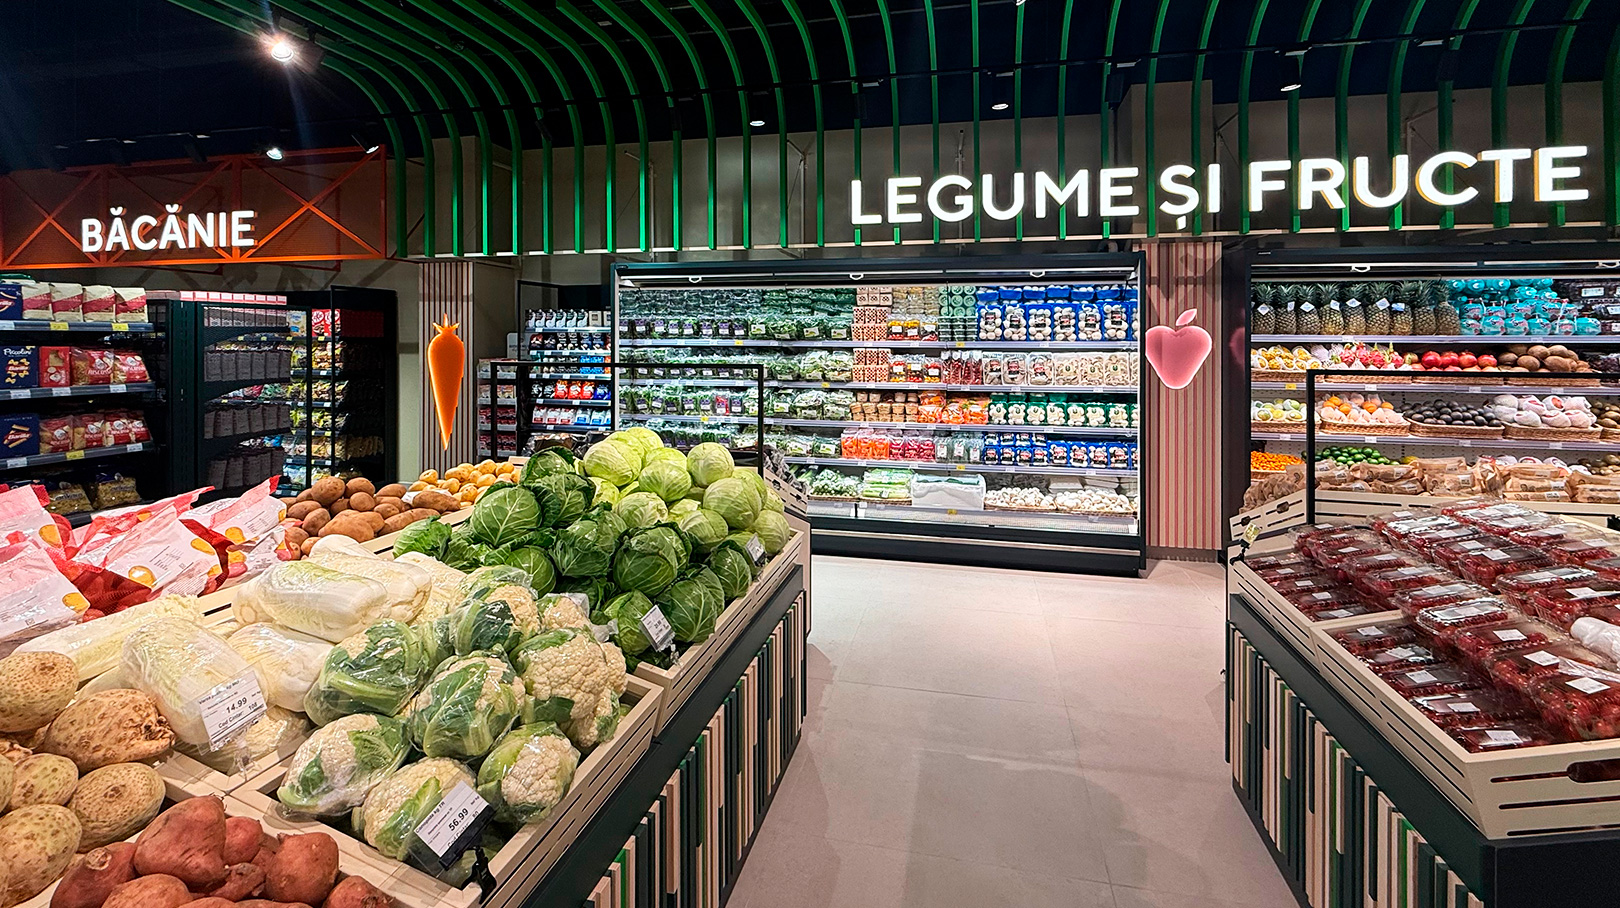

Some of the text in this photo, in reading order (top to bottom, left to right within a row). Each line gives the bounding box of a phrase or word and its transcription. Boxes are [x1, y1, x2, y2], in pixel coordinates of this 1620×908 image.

[851, 145, 1591, 231] LEGUME ȘI FRUCTE
[81, 203, 257, 253] BĂCĂNIE
[226, 697, 247, 713] 14.99
[218, 720, 228, 728] Cod
[448, 808, 469, 832] 56.99
